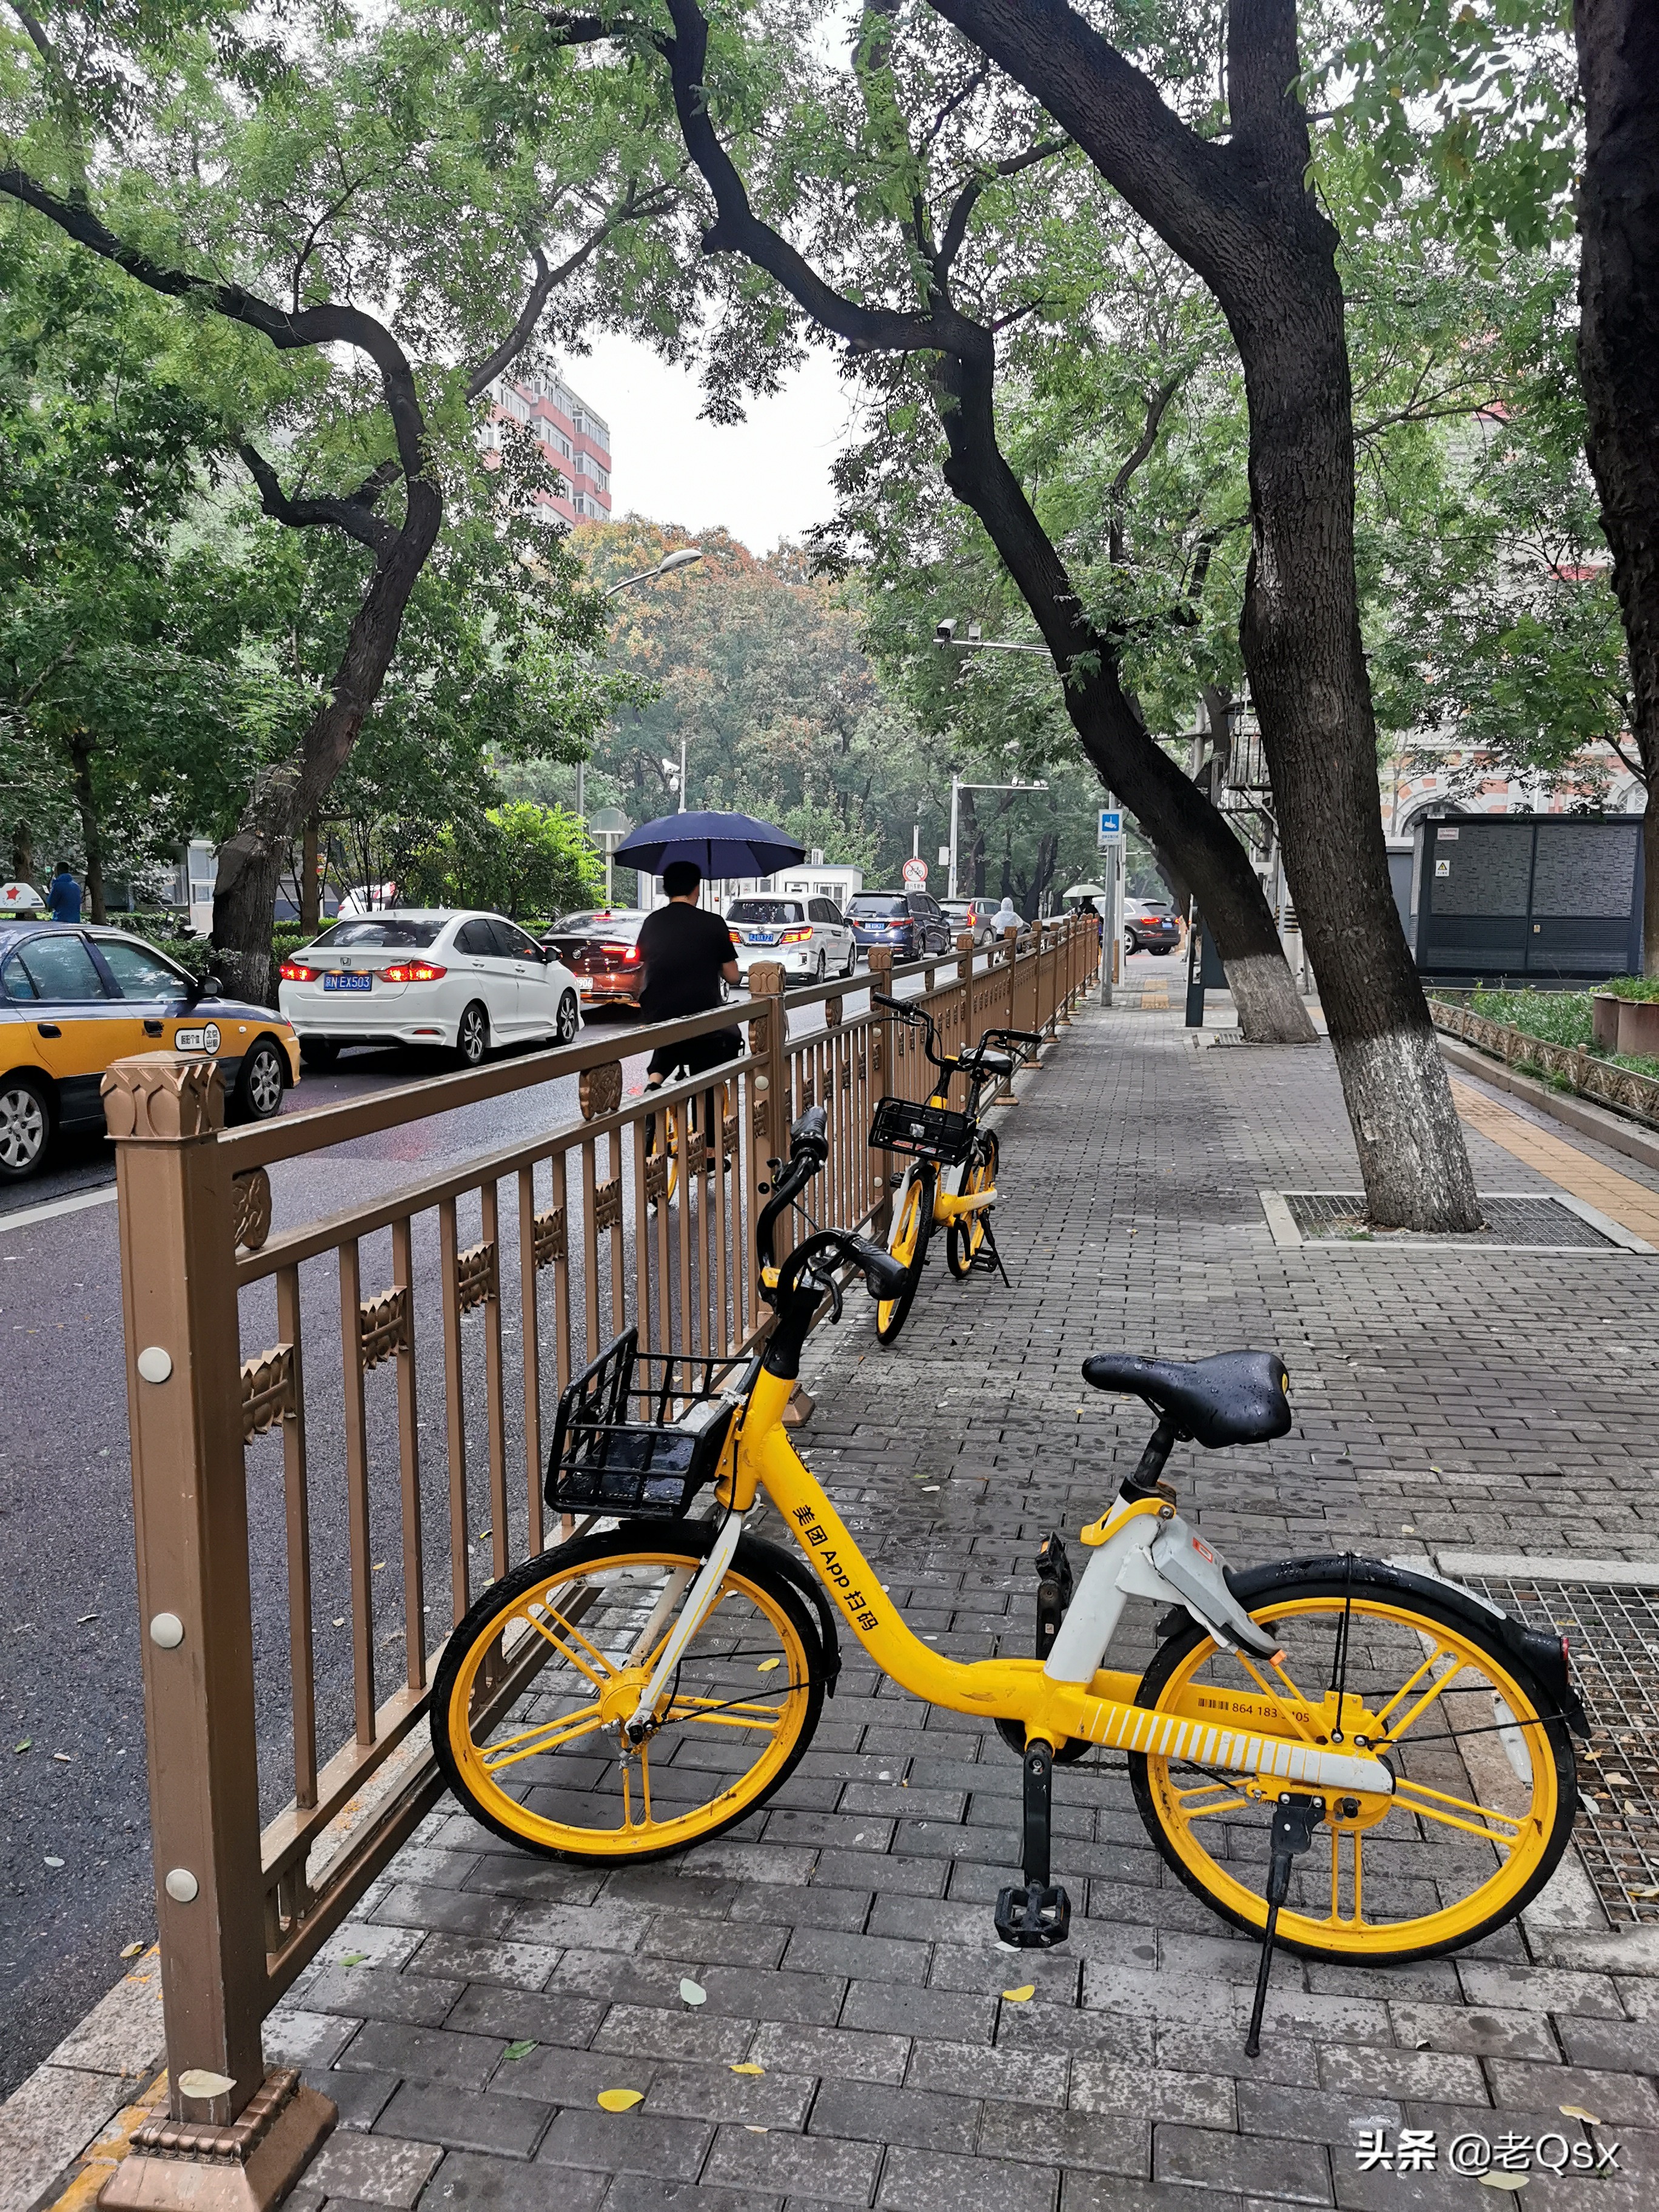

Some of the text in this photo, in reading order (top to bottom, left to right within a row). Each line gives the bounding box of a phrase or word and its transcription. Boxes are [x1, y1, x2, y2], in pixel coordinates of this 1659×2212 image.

[207, 1030, 218, 1039] 北京
[1232, 1702, 1253, 1715] 864
[1258, 1706, 1278, 1718] 183
